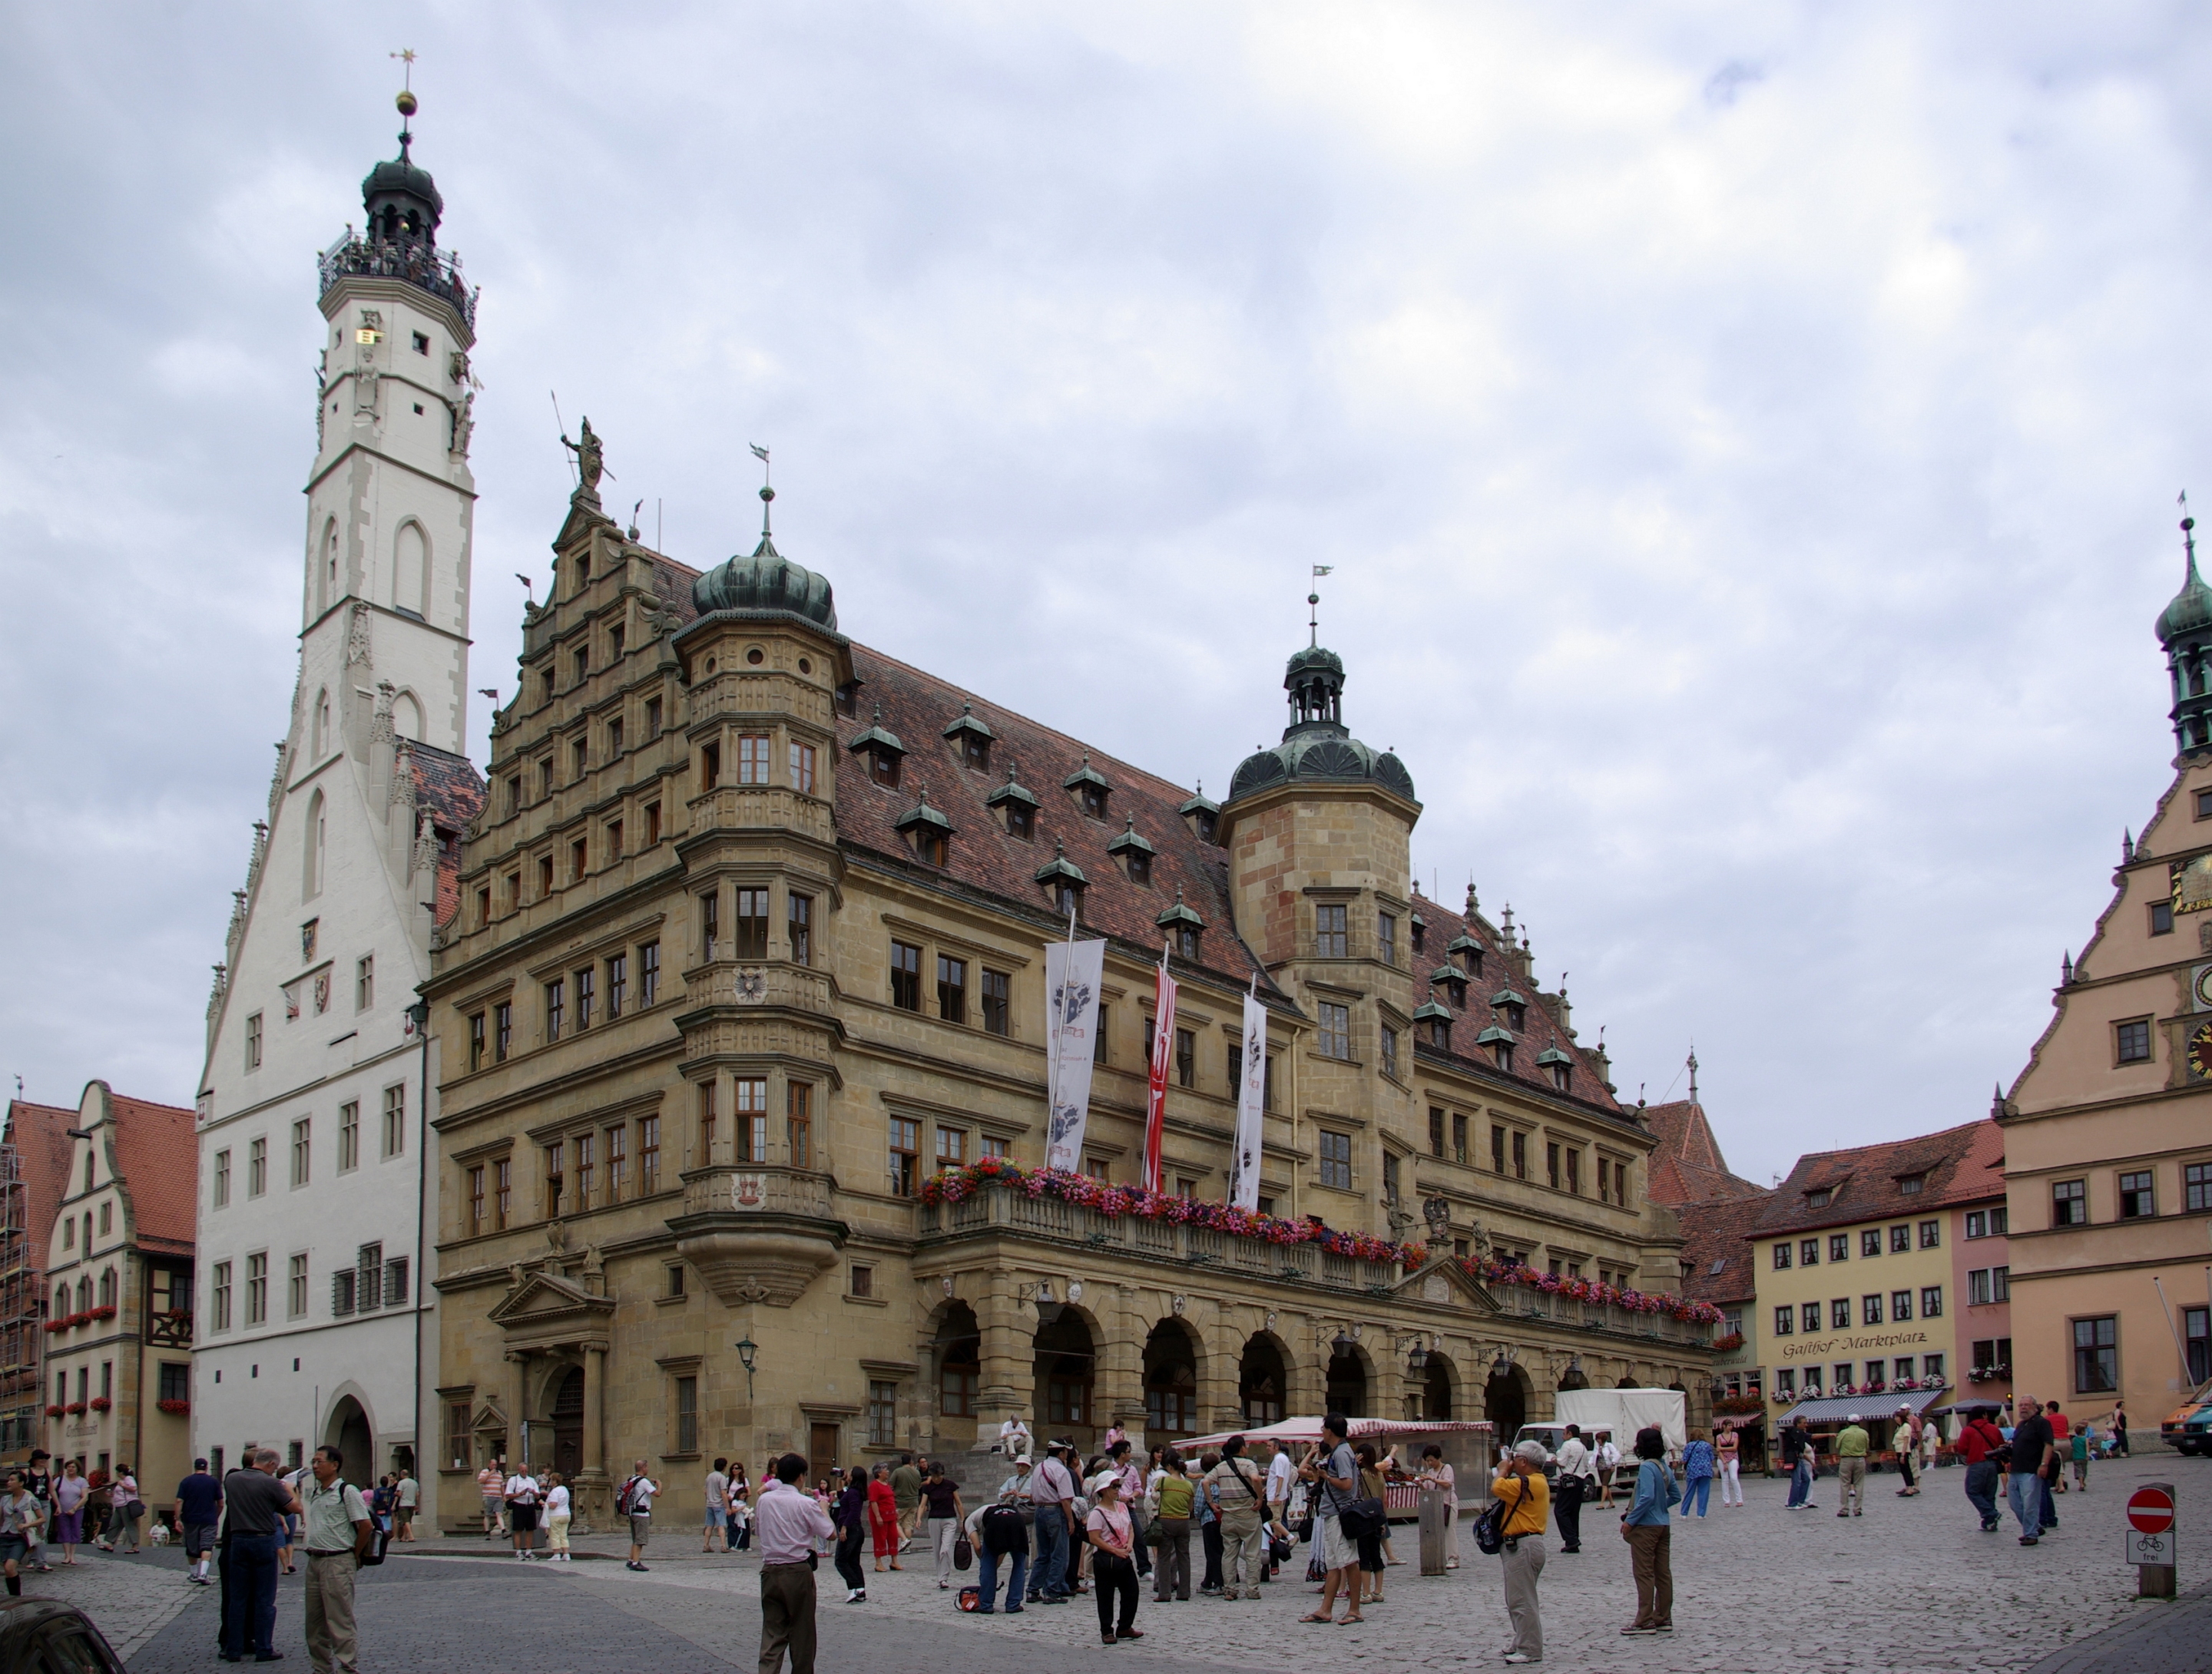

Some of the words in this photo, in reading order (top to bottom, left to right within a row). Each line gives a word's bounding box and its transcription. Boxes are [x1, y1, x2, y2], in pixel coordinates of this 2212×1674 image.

[1840, 1332, 1929, 1350] Marktplatz
[1711, 1355, 1748, 1367] auberwald
[2143, 1553, 2158, 1561] frei
